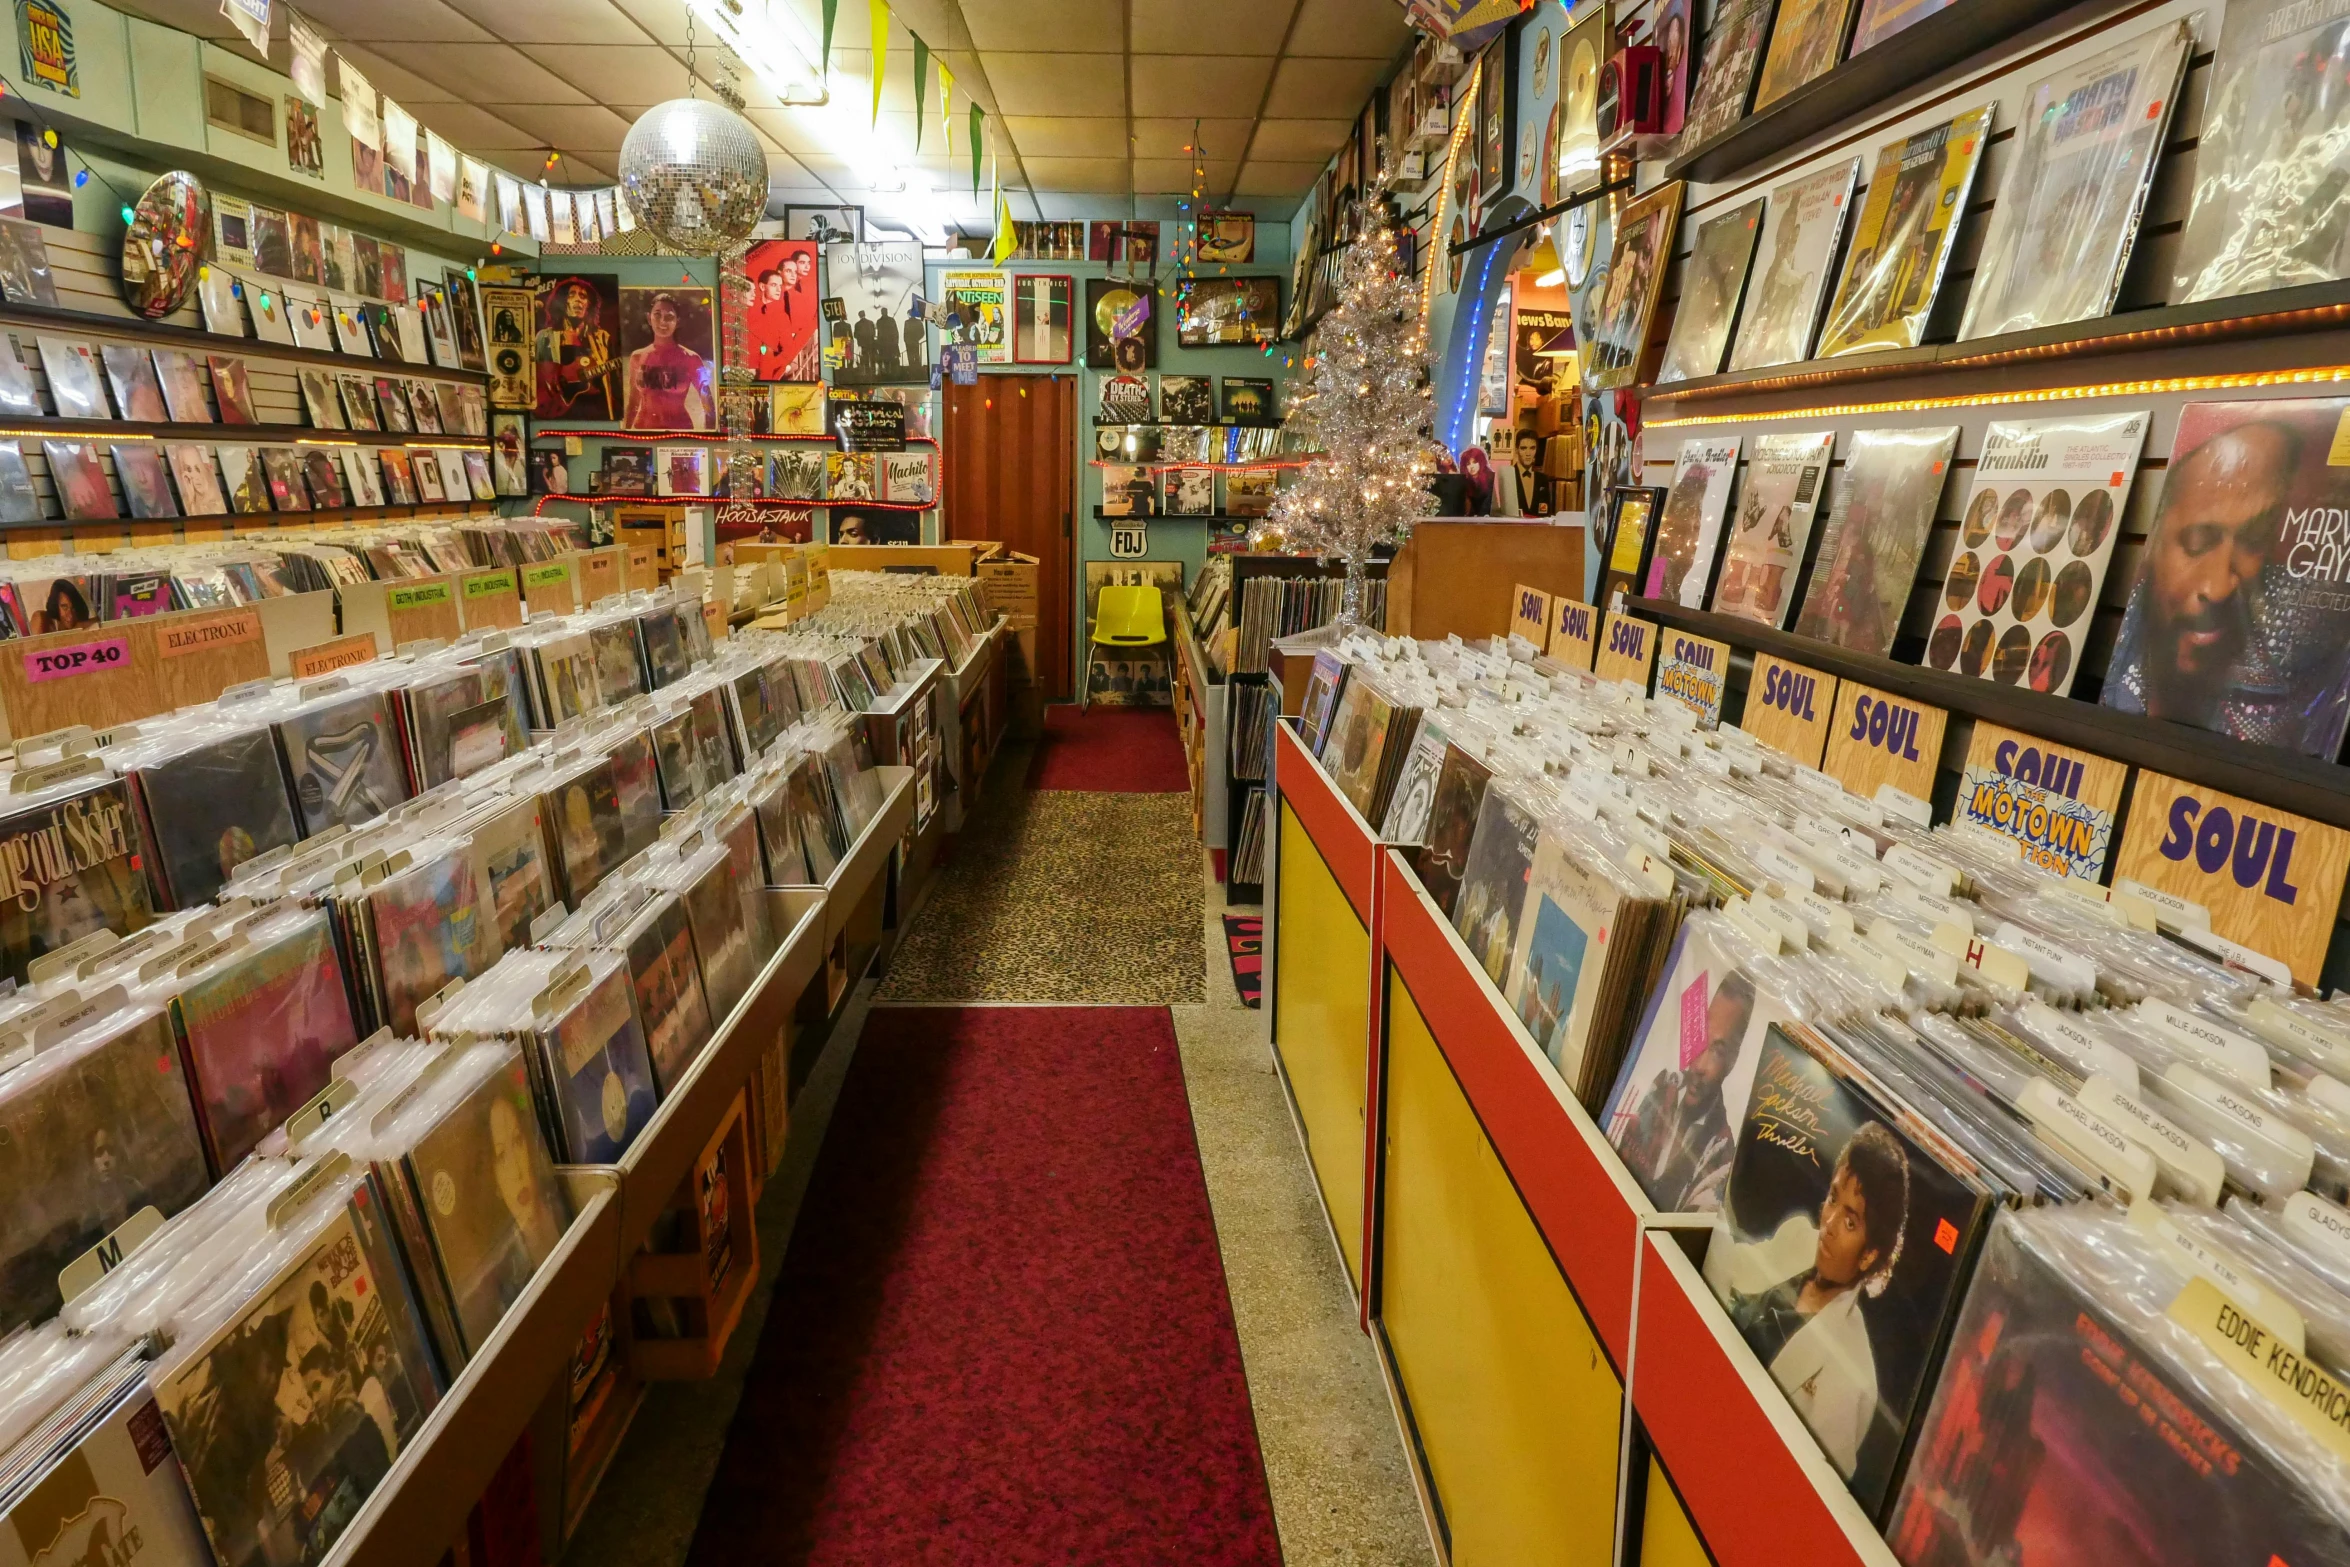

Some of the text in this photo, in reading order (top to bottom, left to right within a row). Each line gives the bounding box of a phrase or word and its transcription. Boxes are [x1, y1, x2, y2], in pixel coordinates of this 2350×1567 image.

[29, 21, 65, 67] USA
[837, 252, 913, 265] JOY DIVISION
[524, 276, 541, 288] BOB
[535, 279, 557, 295] RLEY
[1017, 279, 1068, 288] EURYTHMICS
[951, 345, 977, 353] PLEASED
[958, 352, 971, 362] TO
[953, 362, 976, 372] MEET
[957, 372, 975, 384] ME
[1110, 382, 1142, 396] DEATH
[1704, 447, 1732, 466] Bradley
[1979, 448, 2048, 472] franklin
[2064, 452, 2133, 461] SINGLES COLLECTION
[2079, 445, 2110, 453] ATLANTIC
[887, 460, 927, 484] Machito
[715, 506, 812, 523] HOOBASTANK
[1115, 532, 1142, 554] FDJ
[1519, 592, 1542, 626] SOUL
[168, 620, 249, 650] ELECTRONIC
[1561, 605, 1588, 642] SOUL
[1609, 620, 1643, 662] SOUL
[37, 646, 121, 673] TOP 40
[305, 648, 367, 677] ELECTRONIC
[1661, 669, 1716, 708] MOTOWN
[1763, 664, 1815, 722] SOUL
[1851, 694, 1920, 763] SOUL
[2022, 787, 2046, 804] THE
[1968, 780, 2096, 860] MOTOWN
[30, 795, 128, 885] out Sister
[1962, 824, 2013, 849] ISAAC HAYES
[2160, 795, 2298, 906] SOUL
[1803, 896, 1819, 909] WILLIE
[1917, 893, 1950, 915] IMPRESSIONS
[2138, 886, 2186, 912] CHUCK JACKSON
[1896, 932, 1937, 960] PHYLLIS HYMAN
[1965, 938, 1985, 970] H
[2021, 936, 2064, 964] INSTANT FUNK
[2217, 944, 2231, 958] THE
[157, 952, 178, 970] JESSICA
[2055, 1022, 2093, 1050] JACKSON 5
[2165, 1014, 2227, 1049] MILLIE JACKSON
[2288, 1022, 2334, 1051] RICK JAMES
[1762, 1047, 1836, 1112] Michael
[1752, 1083, 1829, 1136] Jackson
[2112, 1093, 2190, 1153] JERMAINE JACKSON
[2216, 1093, 2263, 1129] JACKSONS
[2056, 1096, 2127, 1153] MICHAEL JACKSON
[1757, 1121, 1821, 1168] Thriller
[287, 1179, 304, 1197] EDDIE
[97, 1236, 123, 1274] M
[2175, 1232, 2196, 1252] BEN
[2214, 1261, 2240, 1289] KING
[2216, 1303, 2267, 1360] EDDIE
